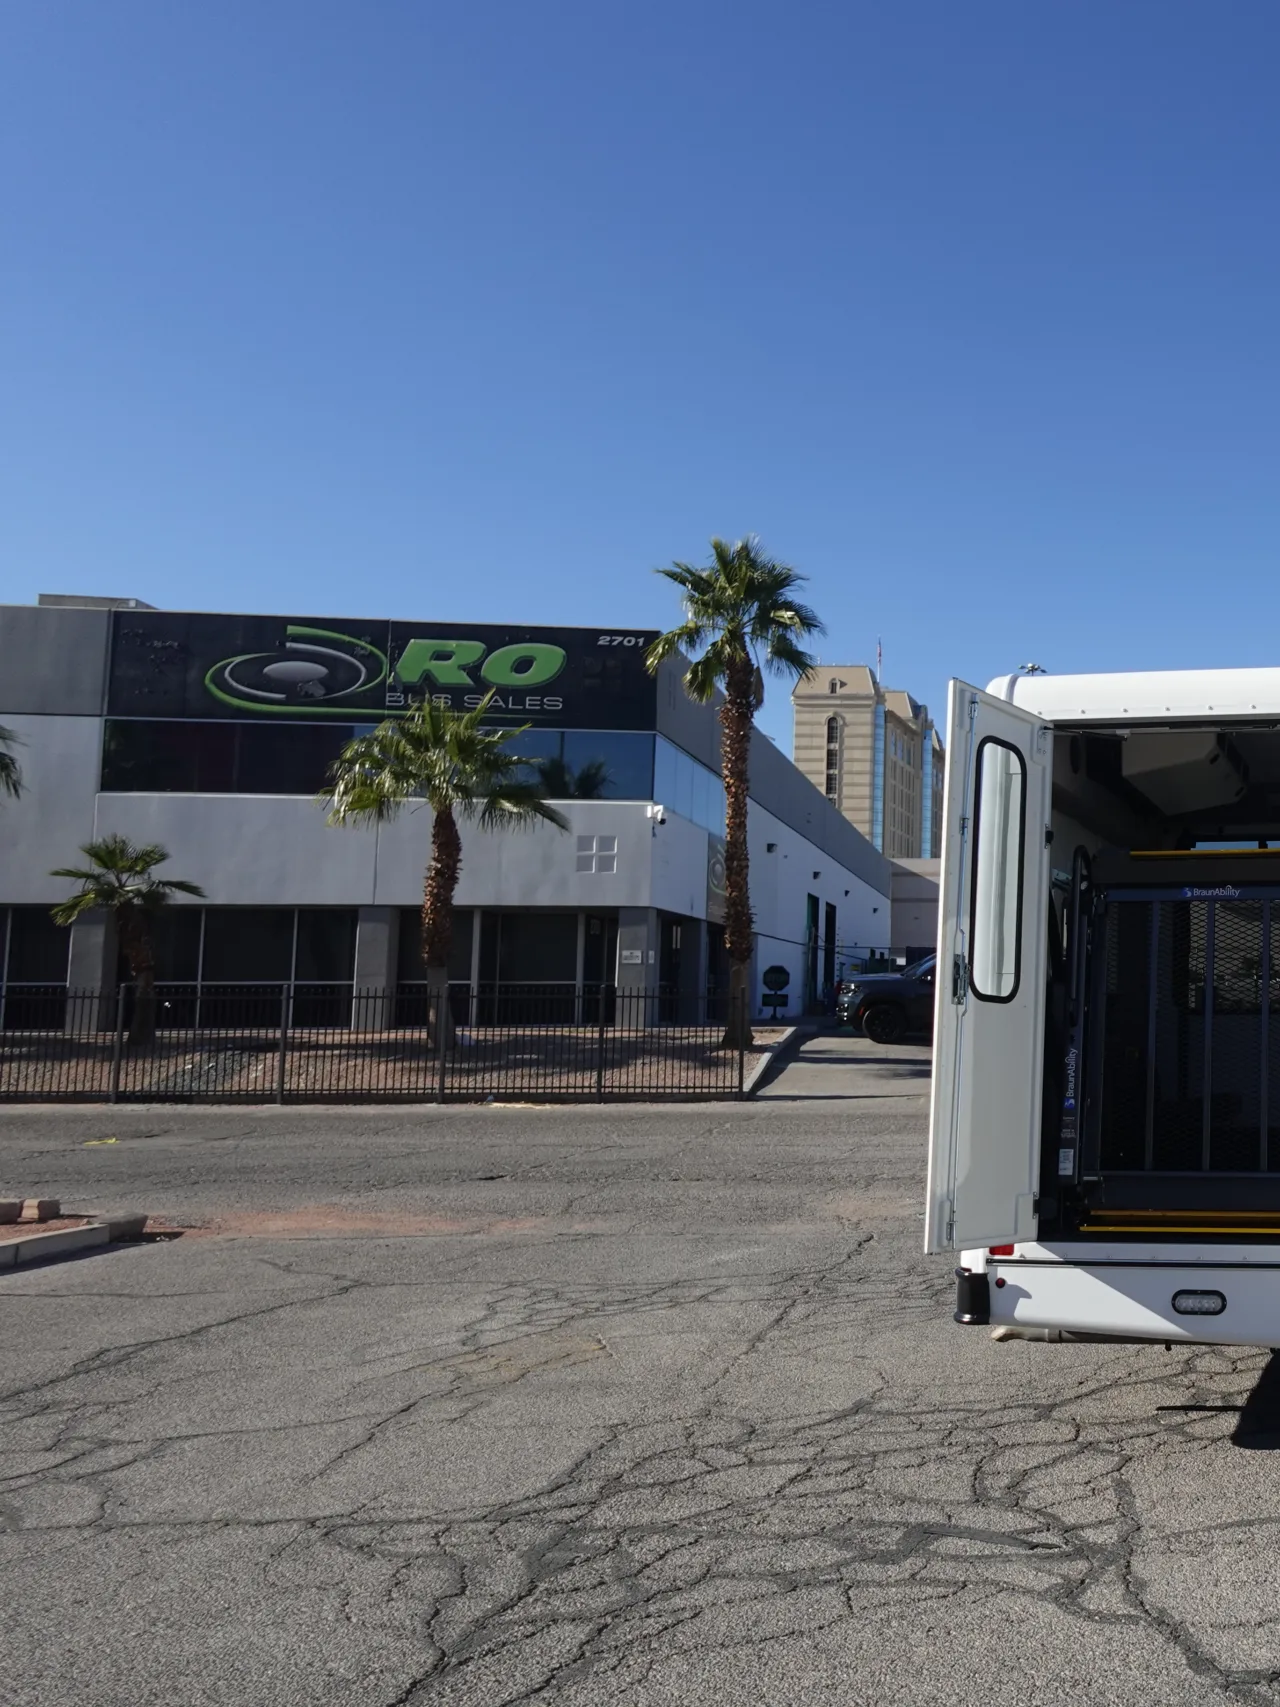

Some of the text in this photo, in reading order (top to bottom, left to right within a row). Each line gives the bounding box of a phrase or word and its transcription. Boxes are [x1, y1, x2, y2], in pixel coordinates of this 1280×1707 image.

[597, 635, 645, 647] 2701
[395, 638, 568, 689] RO
[463, 694, 563, 710] SALES
[1193, 884, 1241, 898] BraunAbility
[1064, 1048, 1078, 1097] BraunAbility
